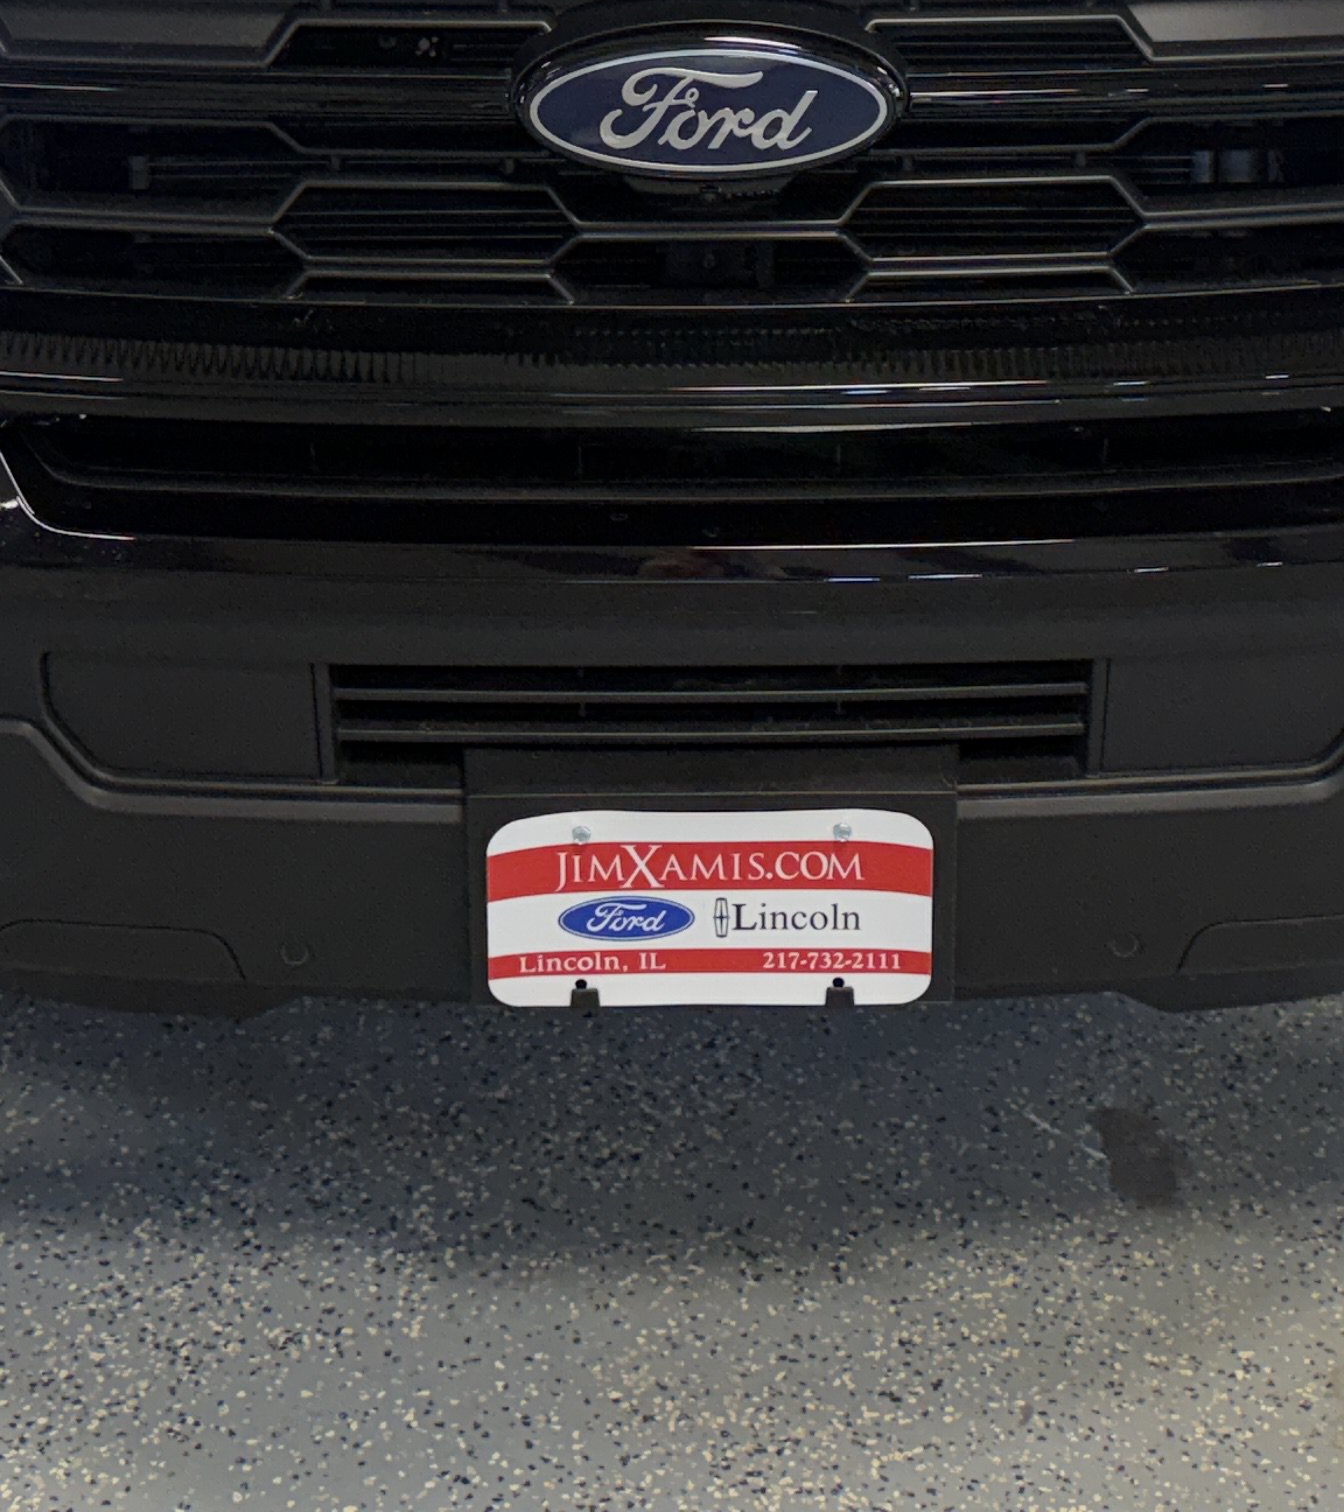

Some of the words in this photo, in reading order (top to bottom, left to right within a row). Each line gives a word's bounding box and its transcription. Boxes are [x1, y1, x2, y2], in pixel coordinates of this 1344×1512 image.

[599, 67, 818, 151] Ford
[556, 845, 864, 892] JIMXAMIS.COM
[586, 902, 667, 933] Ford
[732, 903, 861, 930] Lincoln
[519, 952, 628, 973] Lincoln,
[639, 952, 666, 969] IL
[762, 951, 901, 969] 217-732-2111
